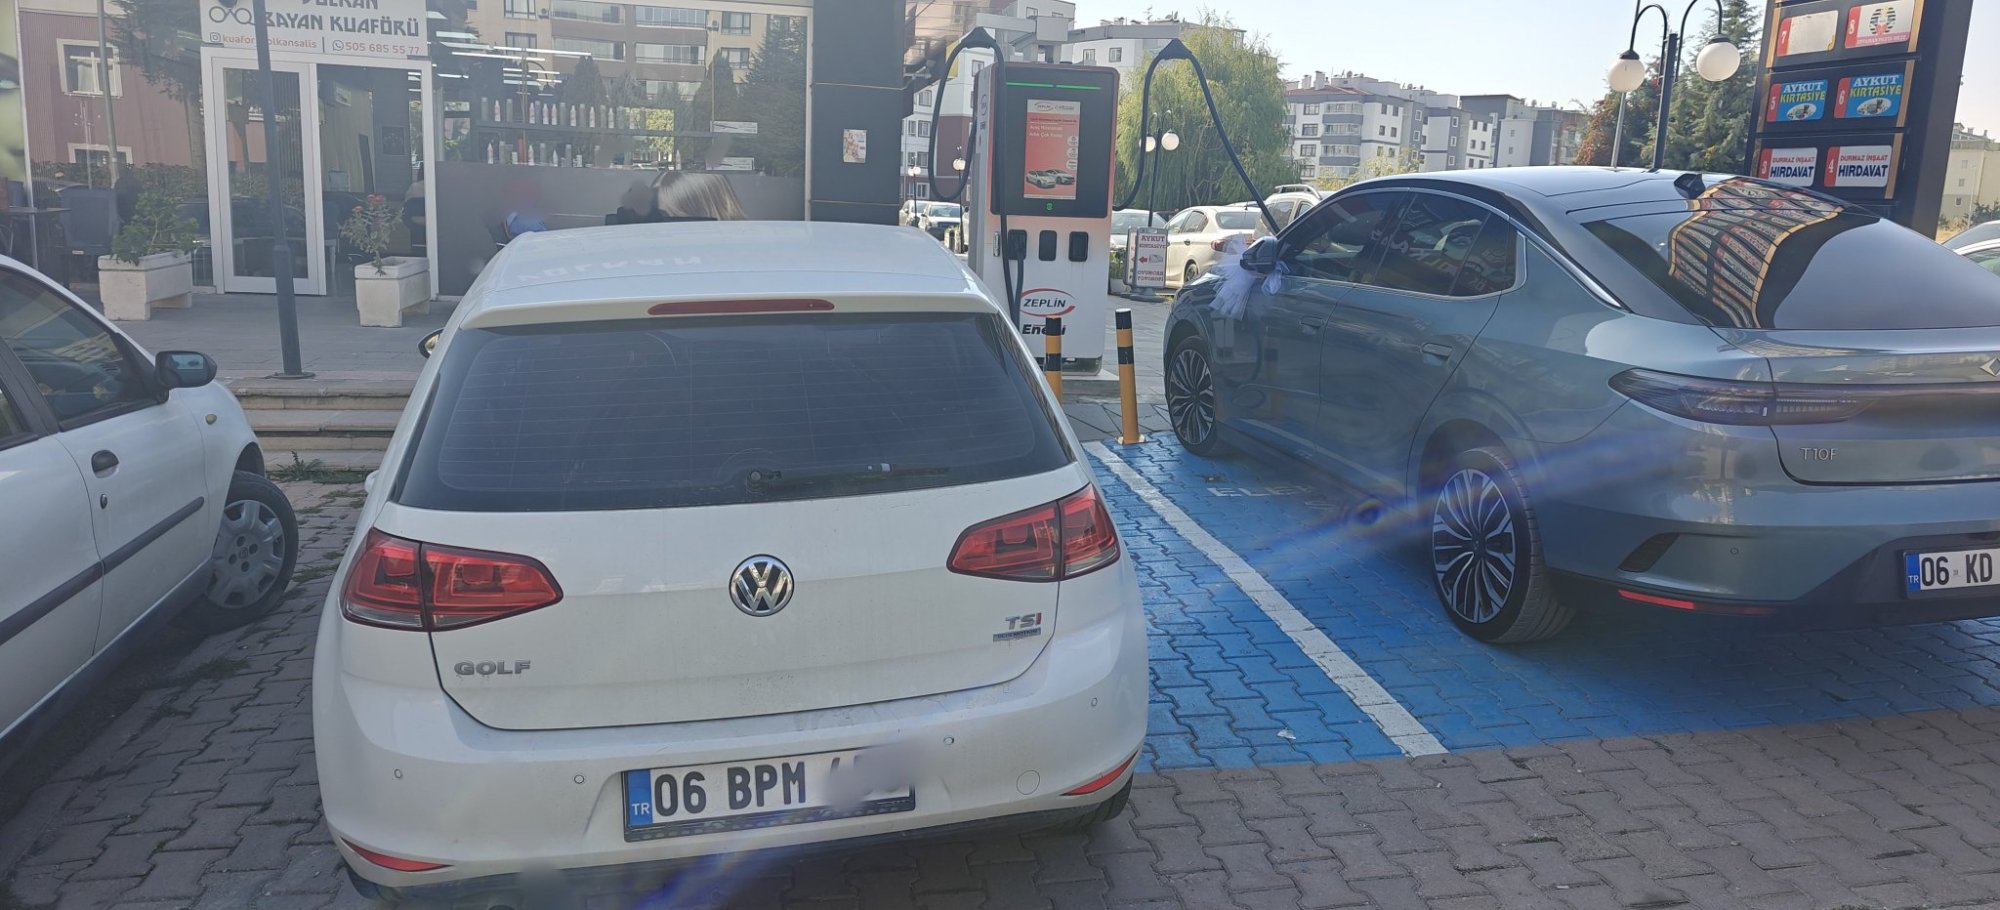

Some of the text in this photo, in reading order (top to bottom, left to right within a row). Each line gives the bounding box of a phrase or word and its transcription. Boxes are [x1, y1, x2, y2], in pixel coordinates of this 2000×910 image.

[265, 11, 419, 37] BAYAN KUAFÖRÜ
[1849, 19, 1856, 35] 8
[1781, 31, 1788, 44] 7
[345, 42, 366, 52] 505
[369, 43, 389, 53] 685
[409, 46, 420, 55] 77
[1783, 81, 1825, 93] AYKUT
[1853, 74, 1900, 87] AYKUT
[1838, 89, 1846, 105] 6
[1850, 84, 1902, 97] KIRTASİYE
[1770, 96, 1777, 111] 5
[1761, 160, 1768, 175] 3
[1770, 166, 1815, 178] HIRDAVAT
[1828, 158, 1834, 174] 4
[1837, 164, 1889, 177] HIRDAVAT
[1023, 297, 1067, 308] ZEPLİN
[1801, 447, 1838, 461] T10F
[1908, 552, 1993, 587] TR 06 KD
[1004, 612, 1042, 630] TSI
[453, 659, 531, 676] GOLF
[631, 802, 651, 816] TR
[653, 770, 708, 817] 06
[726, 760, 808, 811] BPM
